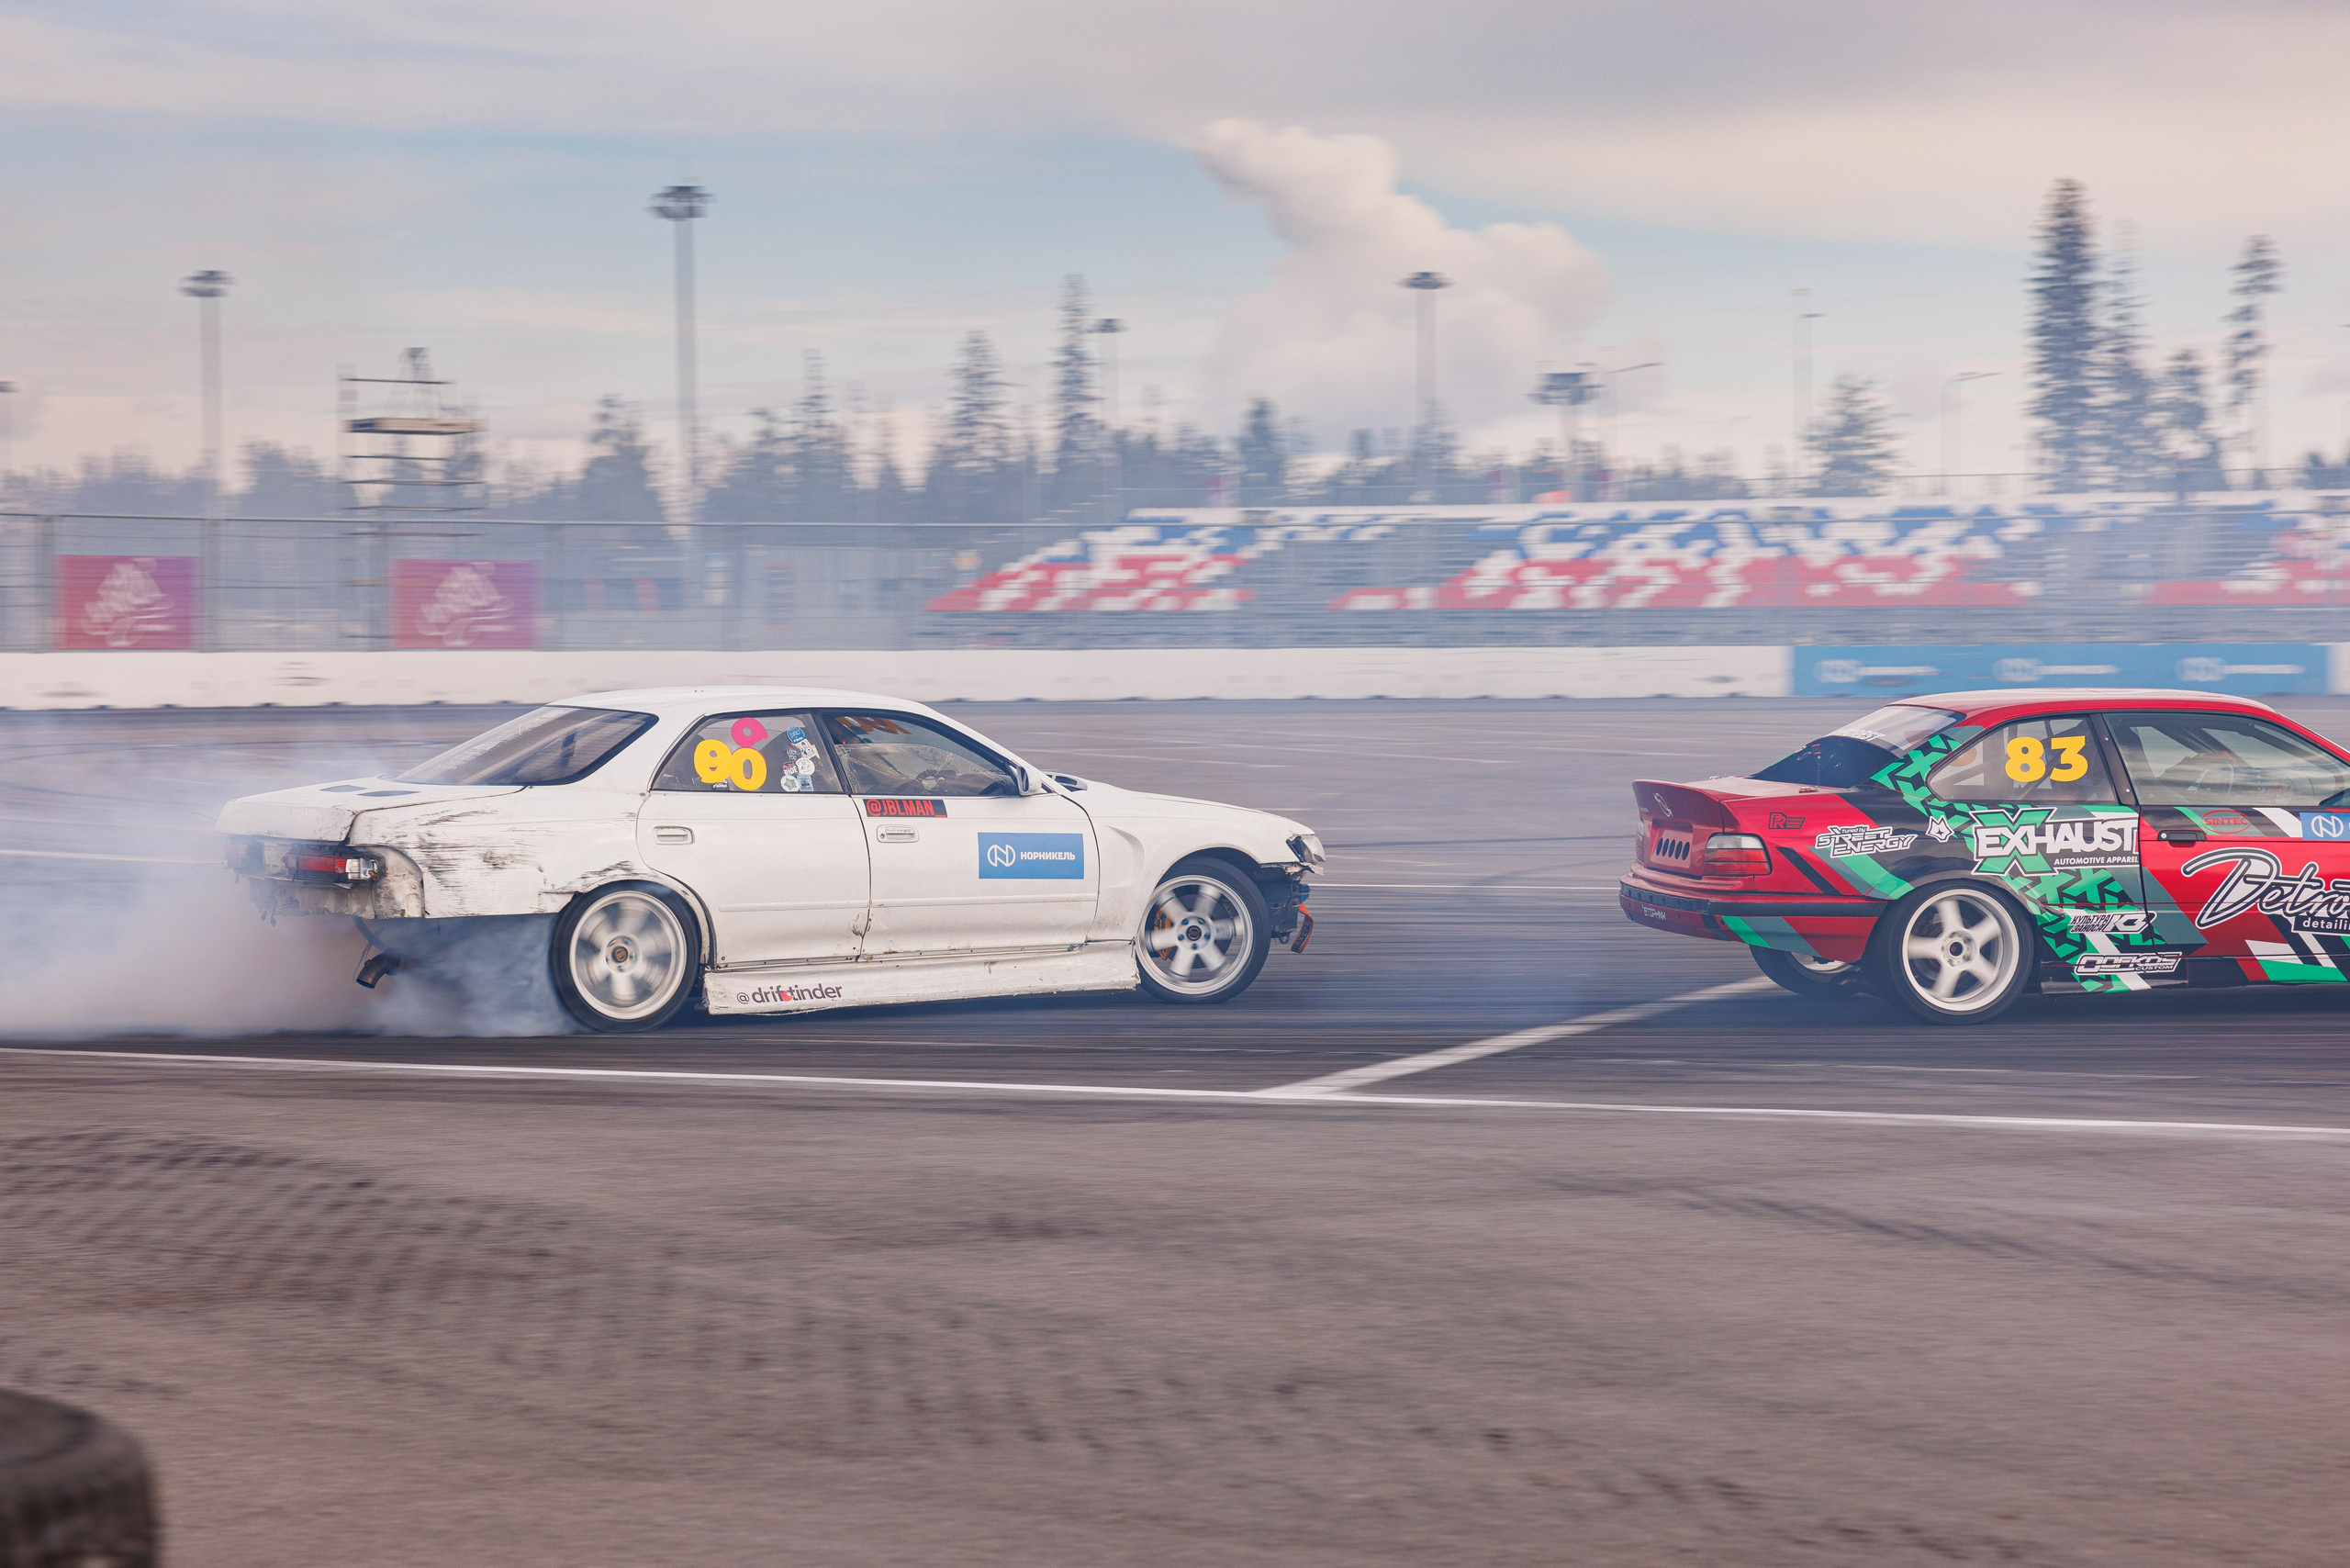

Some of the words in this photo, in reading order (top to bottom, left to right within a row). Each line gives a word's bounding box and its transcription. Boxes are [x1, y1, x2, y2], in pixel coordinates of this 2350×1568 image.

[2005, 735, 2088, 782] 83
[867, 799, 946, 817] @JBLMAN_
[2204, 816, 2247, 825] SINTEC
[1818, 828, 1890, 846] STREET
[1833, 835, 1913, 855] ENERGY
[1972, 807, 2139, 876] EXHAUST
[1020, 851, 1076, 860] НОРНИКЕЛЬ
[2053, 857, 2106, 866] AUTOMOTIVE
[2181, 847, 2350, 929] Detro
[2070, 914, 2111, 924] КУЛЬТУРА
[2071, 924, 2105, 933] ЗАНОСА
